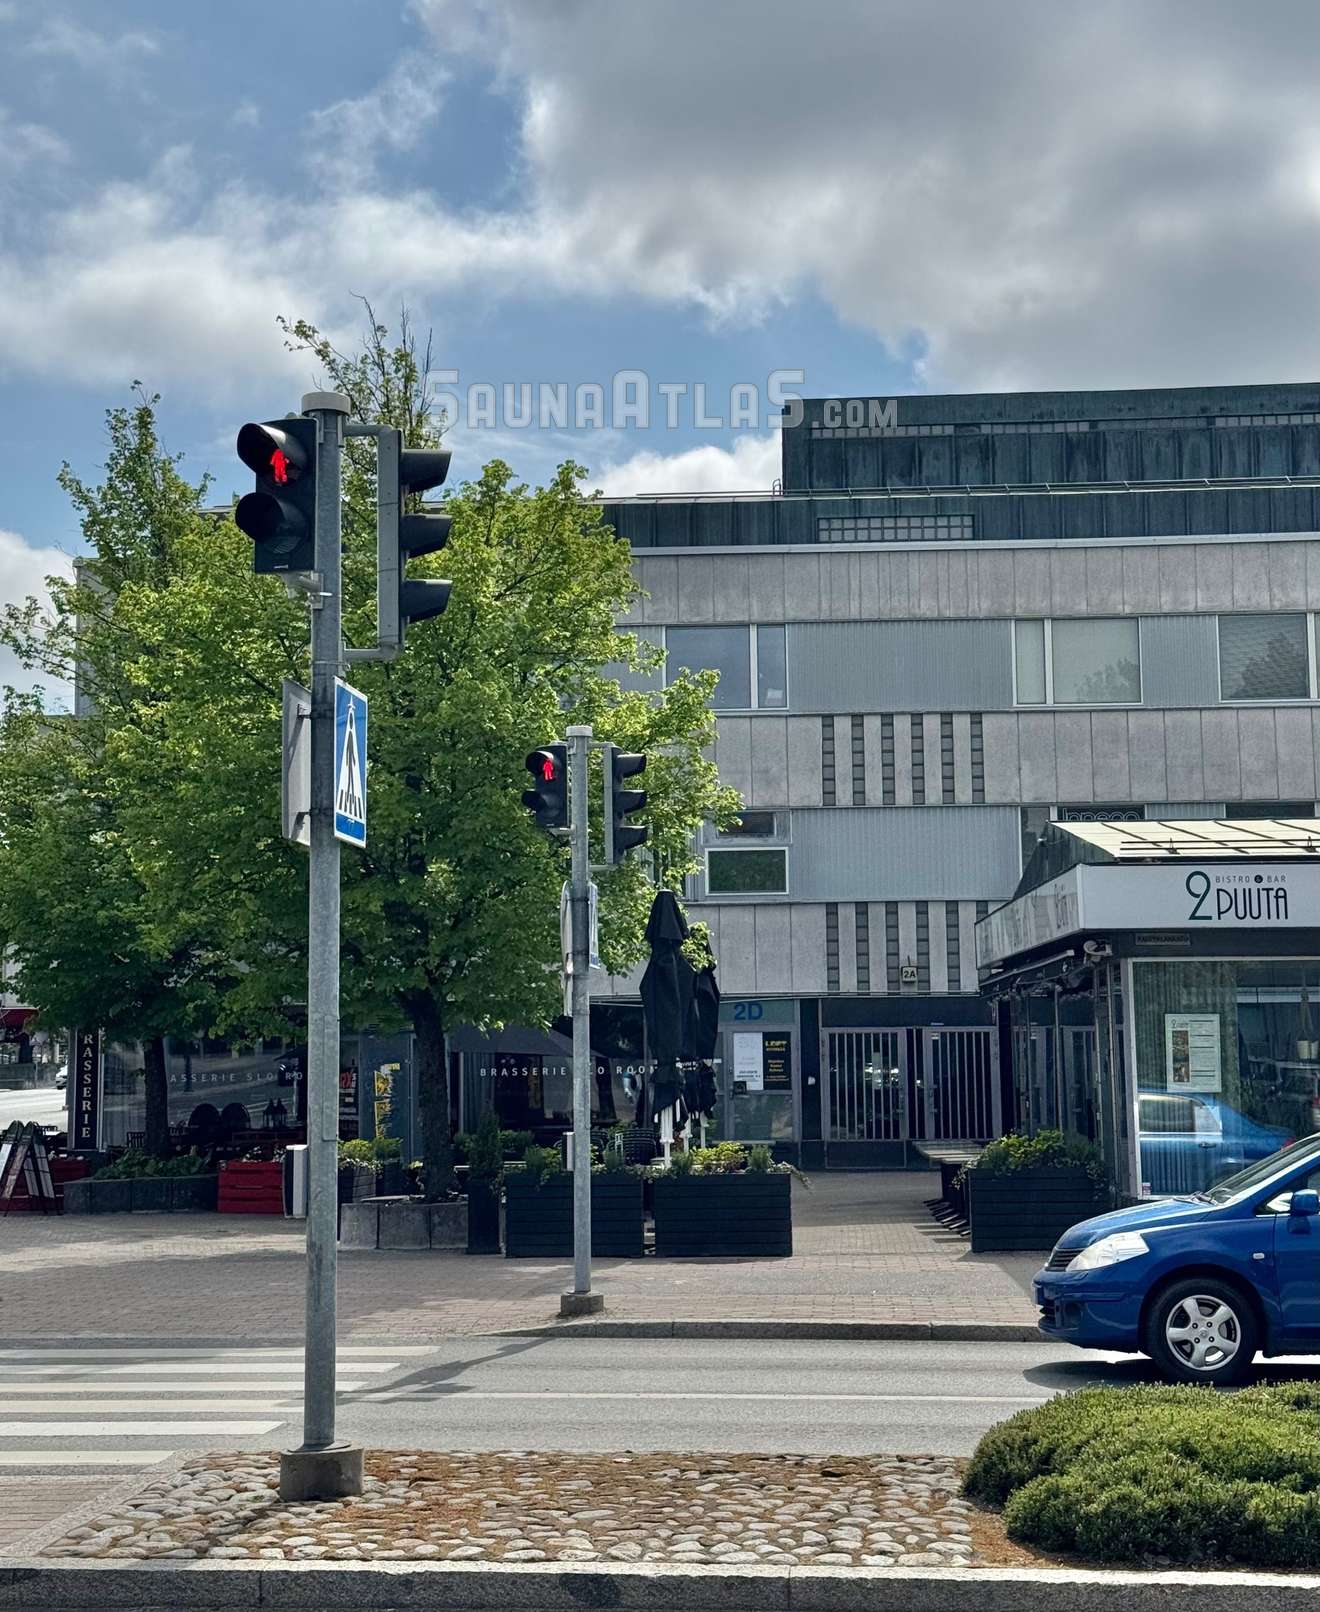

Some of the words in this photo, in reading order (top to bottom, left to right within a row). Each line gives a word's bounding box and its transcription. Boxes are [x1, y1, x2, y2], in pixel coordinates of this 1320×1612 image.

[1215, 875, 1251, 884] BISTRO
[1267, 875, 1287, 883] BAR
[1185, 870, 1213, 920] 2
[1216, 887, 1289, 920] PUUTA
[903, 970, 916, 979] 2A
[734, 1003, 763, 1020] 2D
[480, 1067, 567, 1077] BRASSERIE
[169, 1073, 236, 1082] ASSERIE
[81, 1034, 94, 1138] RASSERIE
